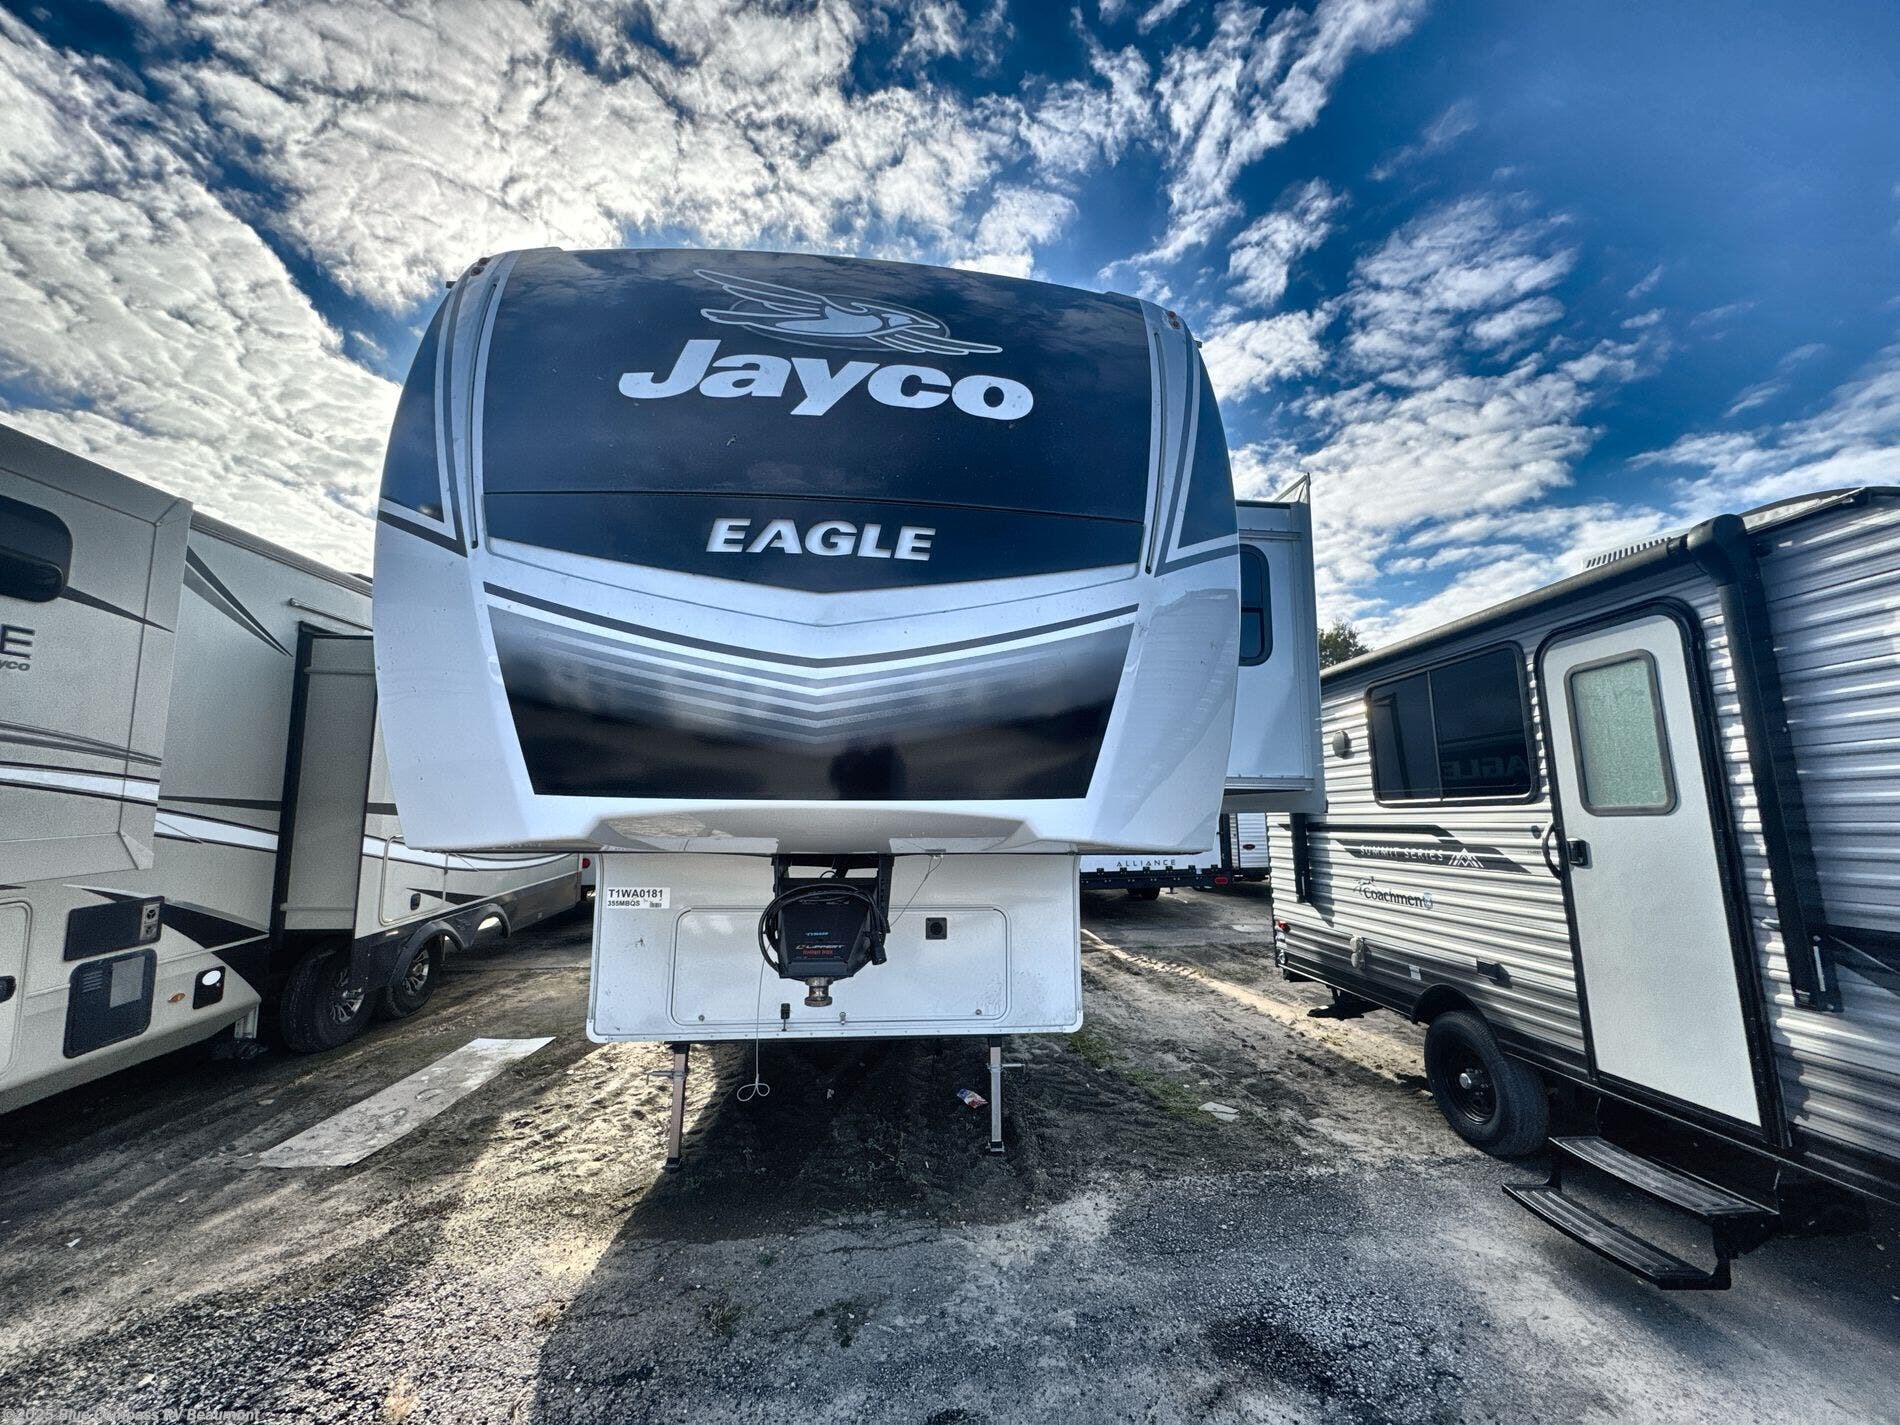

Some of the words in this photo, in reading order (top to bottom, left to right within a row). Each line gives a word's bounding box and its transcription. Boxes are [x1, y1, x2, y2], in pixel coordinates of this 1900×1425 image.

[618, 339, 1034, 421] Jayco
[706, 518, 937, 562] EAGLE
[1360, 845, 1400, 857] SUMMIT
[1403, 848, 1443, 861] SERIES
[1116, 859, 1176, 867] ALLIANCE
[608, 889, 663, 898] T1WA0181
[1363, 887, 1425, 908] Coachmen
